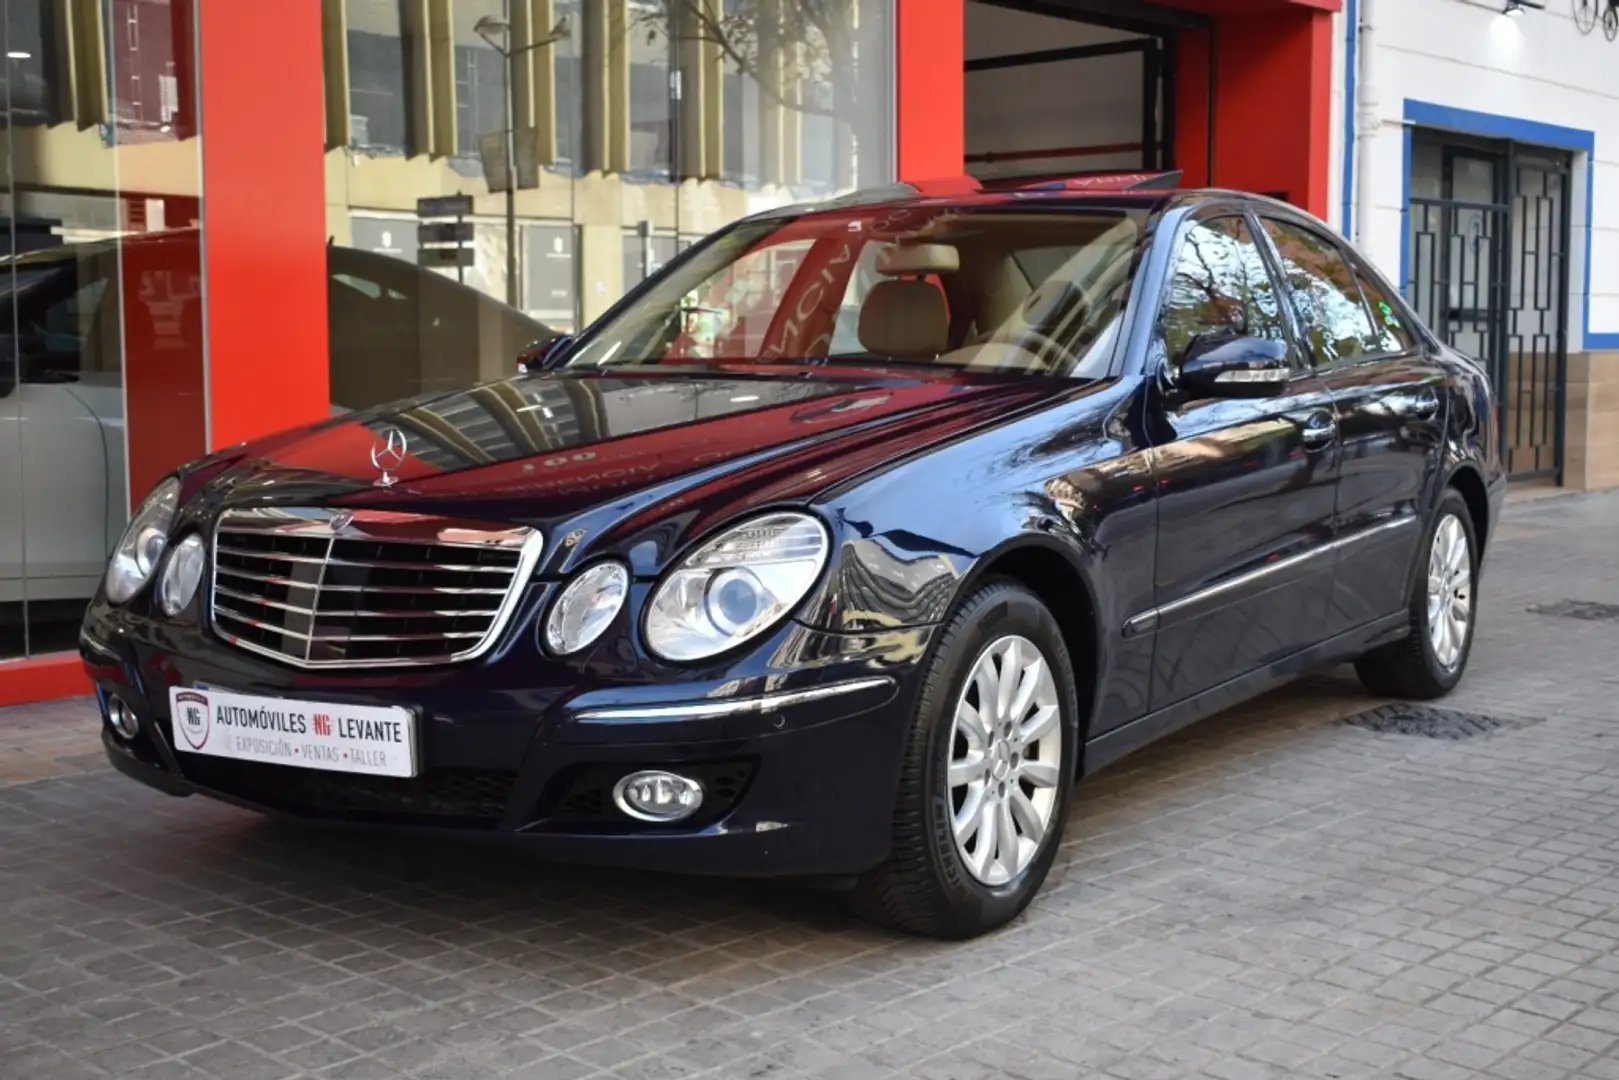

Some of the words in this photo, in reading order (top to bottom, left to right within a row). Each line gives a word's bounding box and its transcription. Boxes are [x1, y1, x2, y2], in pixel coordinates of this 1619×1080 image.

[216, 705, 307, 734] AUTOMÓVILES
[338, 717, 402, 743] LEVANTE
[235, 735, 293, 757] EXPOSICIÓN
[301, 743, 340, 763] VENTAS
[349, 747, 387, 767] TALLER
